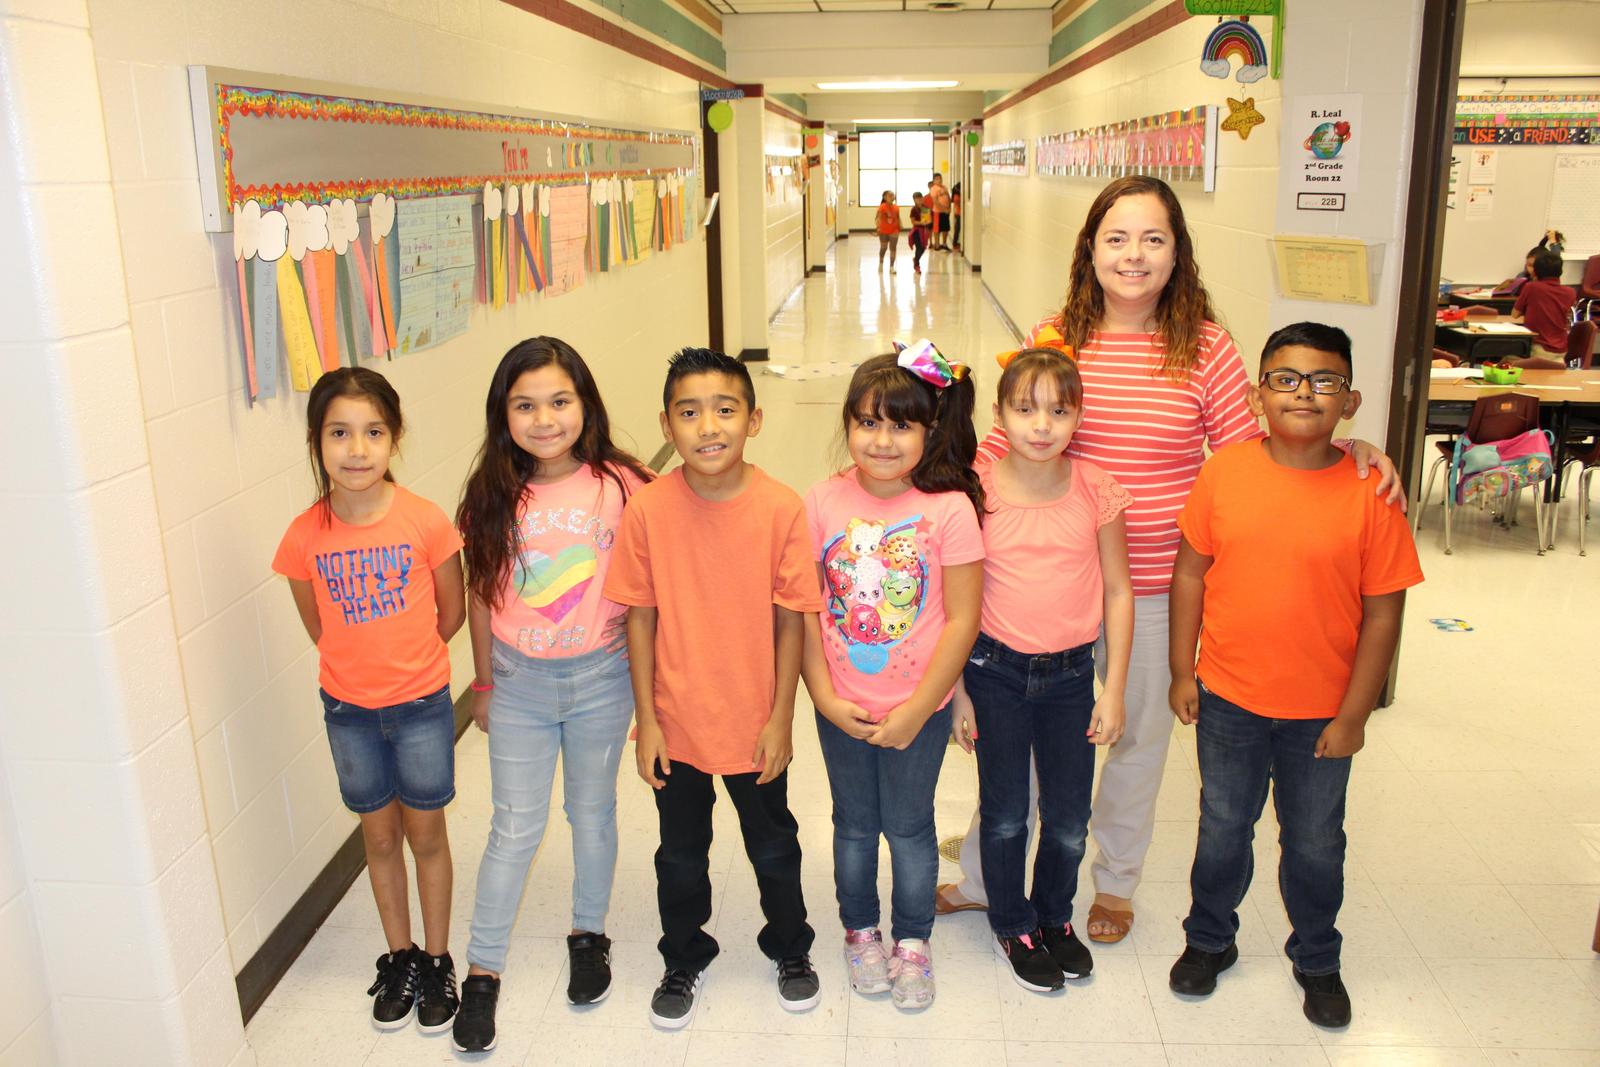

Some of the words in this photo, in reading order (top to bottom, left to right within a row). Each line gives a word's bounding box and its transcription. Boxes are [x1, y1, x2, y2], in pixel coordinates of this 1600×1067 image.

[1311, 110, 1321, 118] R.
[1323, 109, 1342, 118] Leal
[1469, 128, 1496, 144] USE
[1513, 131, 1521, 141] a
[1305, 174, 1329, 182] Room
[1321, 198, 1337, 206] 22B
[511, 507, 615, 551] EKEND
[315, 543, 413, 579] NOTHING
[326, 573, 367, 603] BUT
[341, 587, 406, 625] HEART
[517, 624, 586, 651] FEVER
